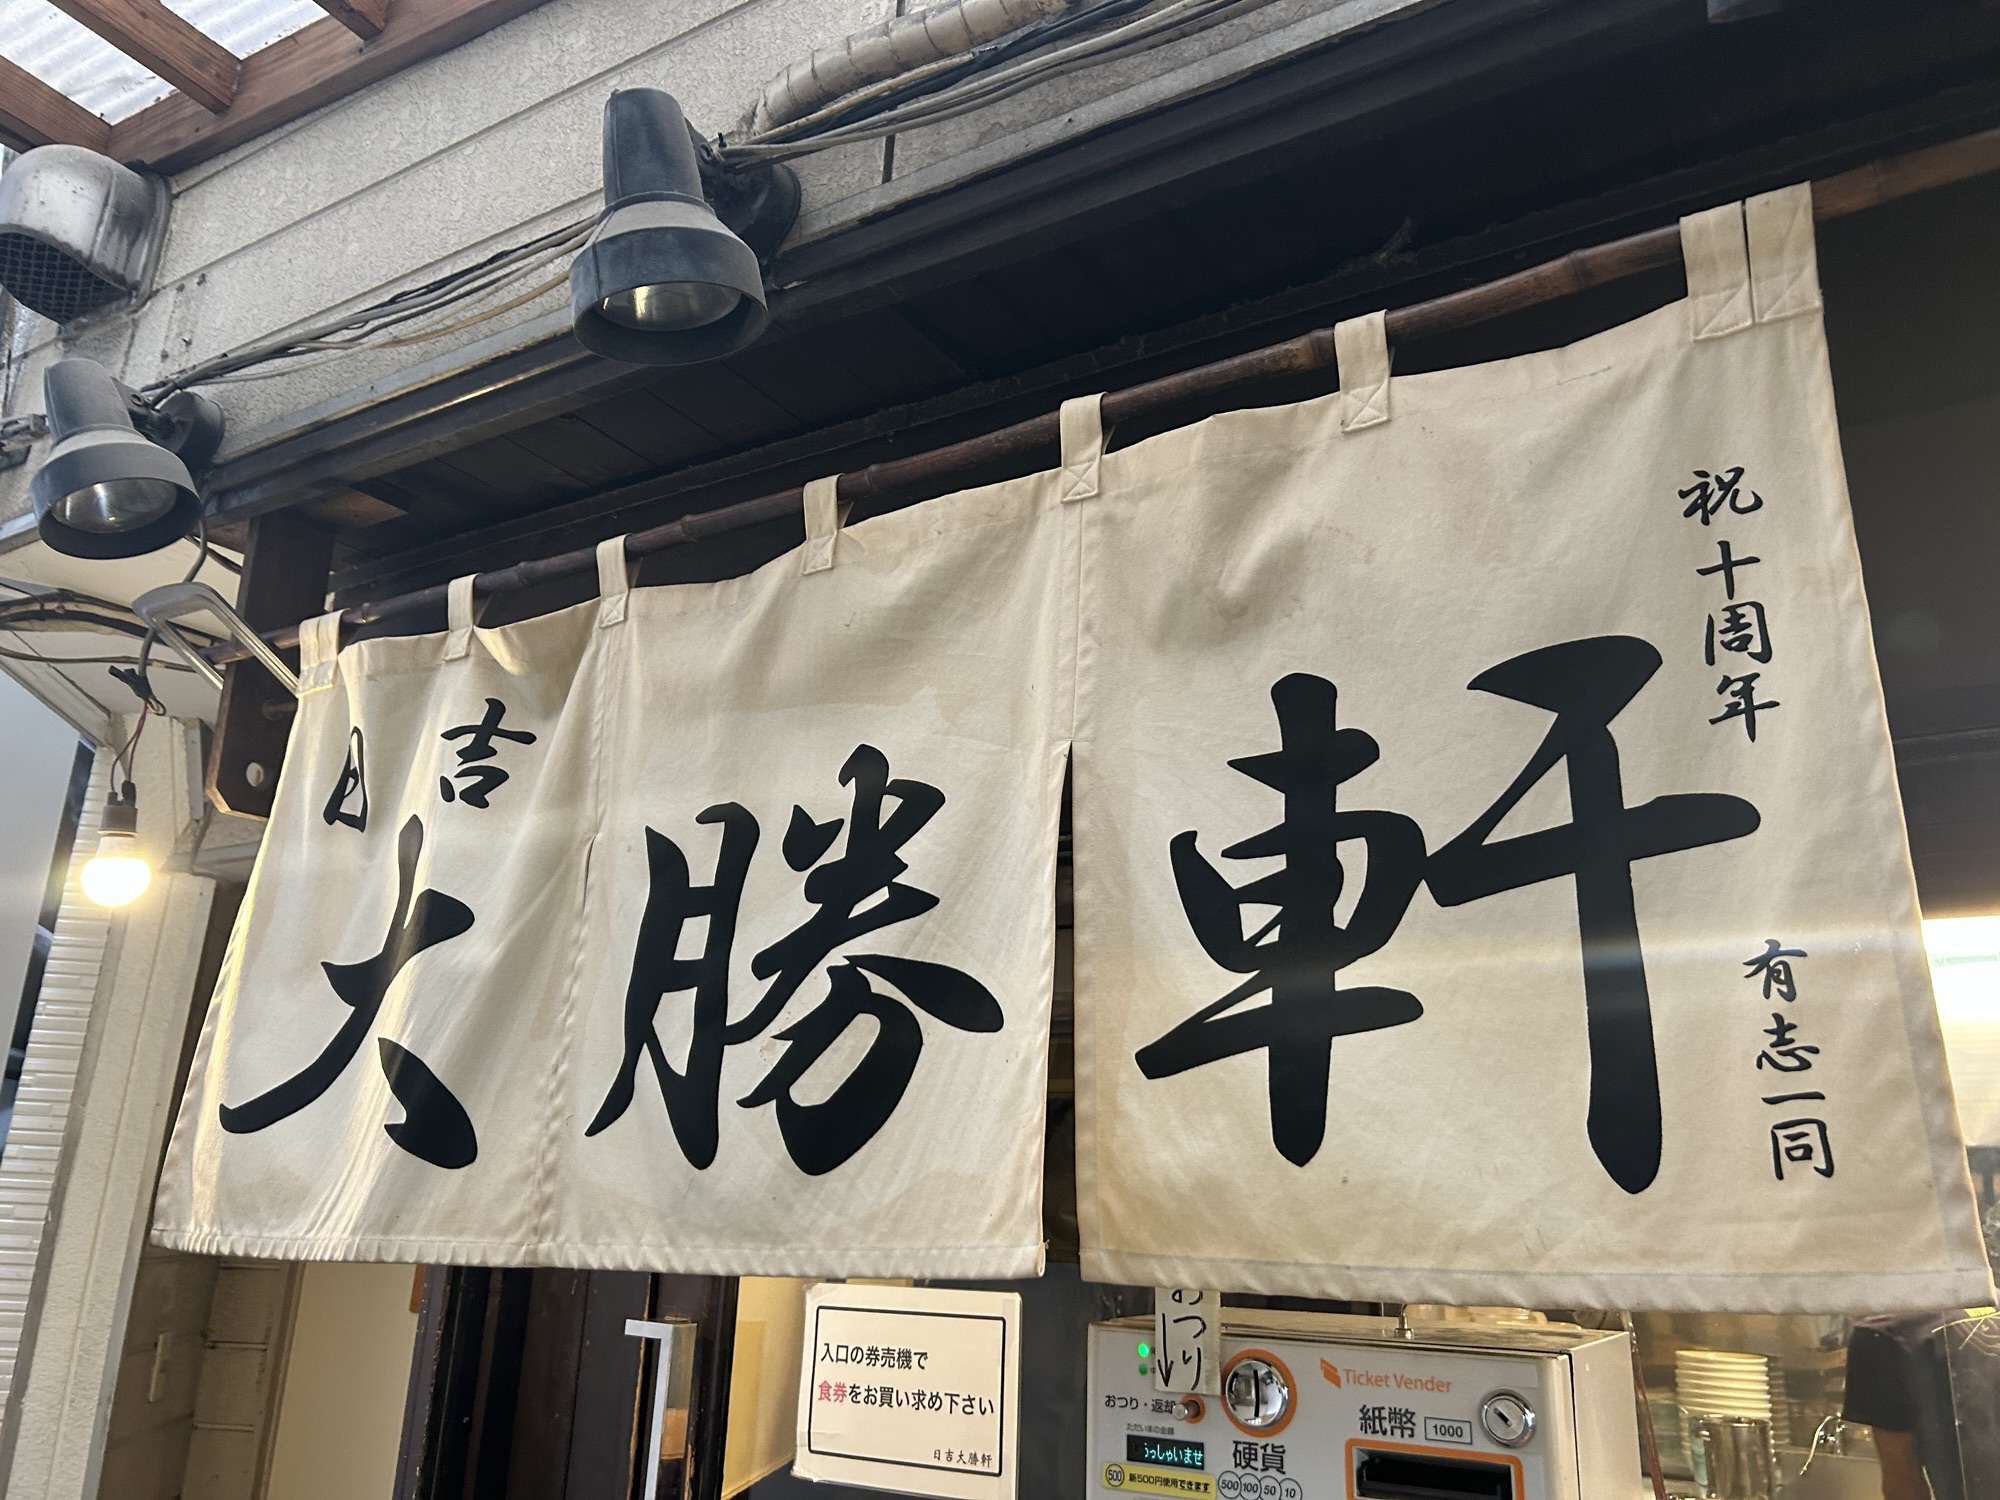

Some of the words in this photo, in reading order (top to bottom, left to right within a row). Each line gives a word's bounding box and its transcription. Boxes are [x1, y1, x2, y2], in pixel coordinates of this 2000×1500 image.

[1678, 466, 1780, 743] 祝十周年
[323, 698, 537, 832] 日吉
[219, 744, 1760, 1194] 大勝軒
[1743, 938, 1834, 1181] 有志一同
[820, 1343, 929, 1371] 入口の券売機で
[1343, 1368, 1390, 1388] Ticket
[1393, 1373, 1452, 1393] Vender
[817, 1380, 995, 1416] 食券をお買い求め下さい
[1359, 1404, 1416, 1438] 紙幣
[1432, 1423, 1464, 1438] 1000
[932, 1448, 993, 1469] 日吉大勝軒
[1232, 1440, 1286, 1475] 硬貨
[1108, 1469, 1122, 1482] 500
[1129, 1472, 1210, 1493] 新500円使用できます
[1221, 1479, 1239, 1491] 500
[1243, 1482, 1259, 1493] 100
[1263, 1485, 1276, 1496] 50
[1285, 1488, 1296, 1498] 10
